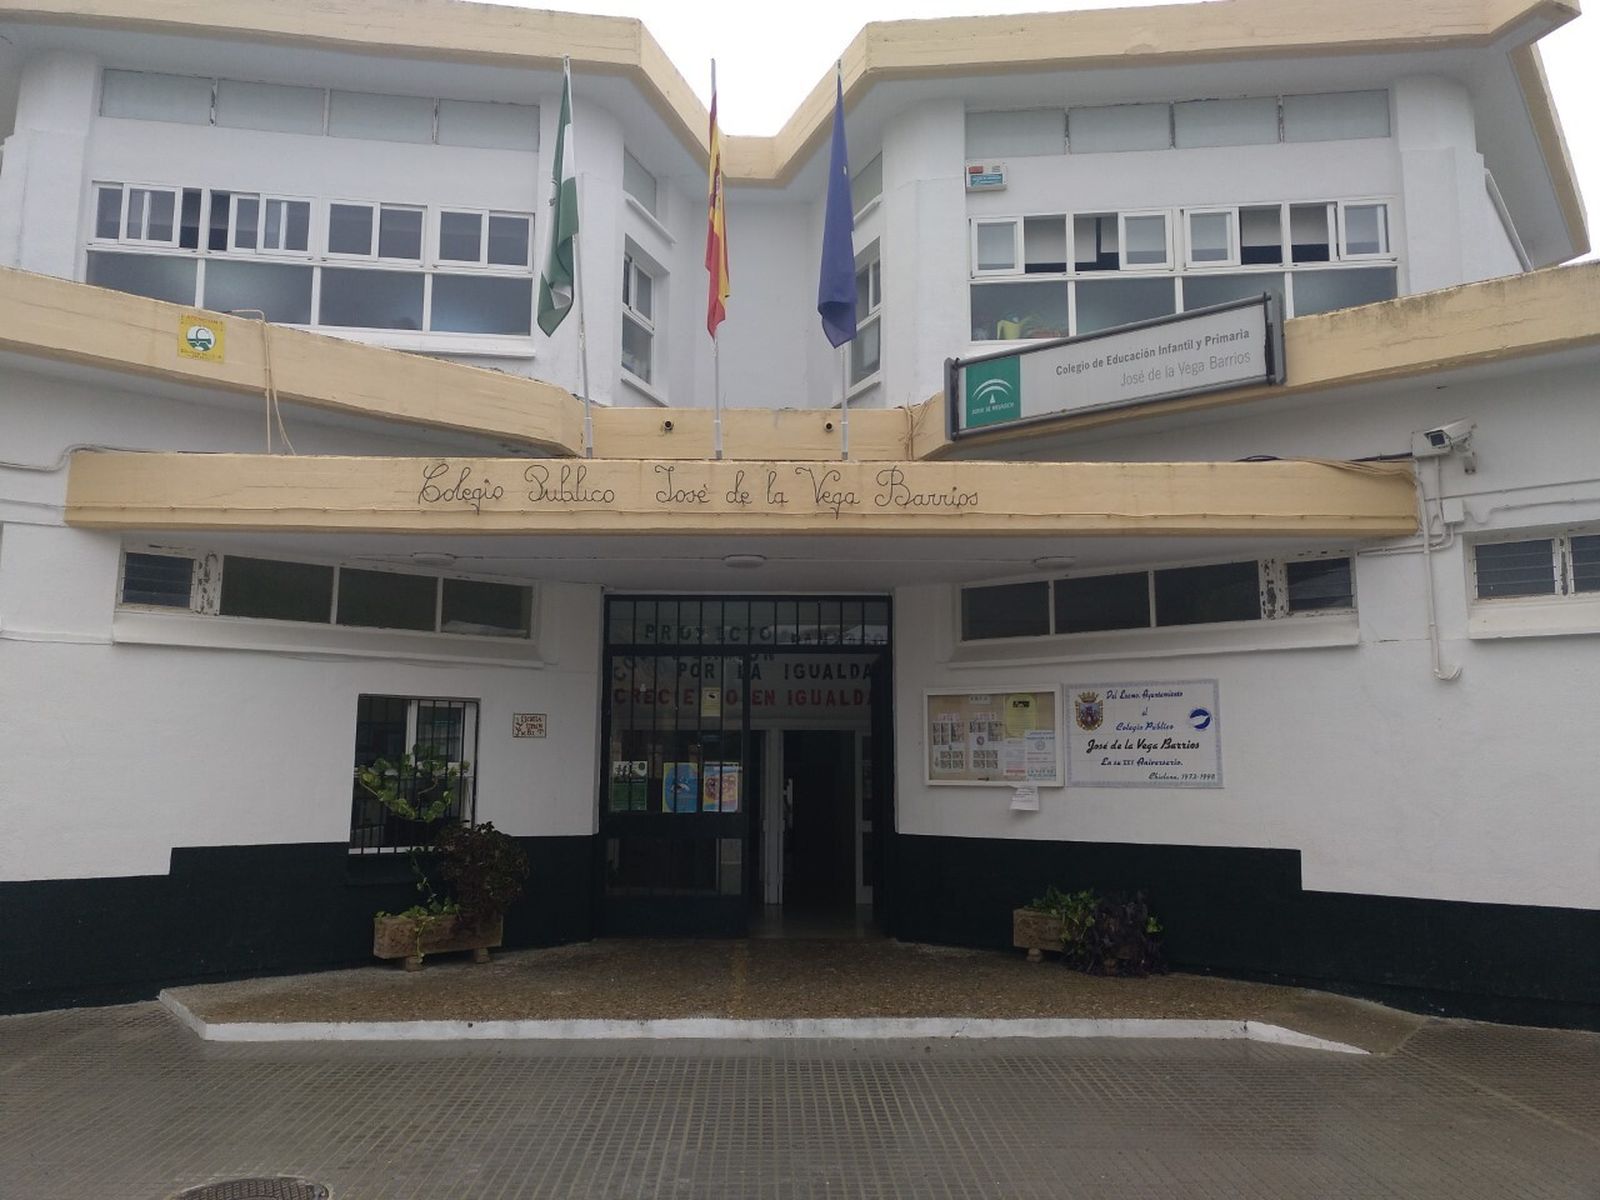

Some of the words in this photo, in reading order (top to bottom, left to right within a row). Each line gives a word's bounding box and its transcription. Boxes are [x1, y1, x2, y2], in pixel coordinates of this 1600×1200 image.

[1056, 363, 1090, 376] Colegio
[1092, 358, 1104, 369] de
[1106, 347, 1156, 366] Educación
[1159, 339, 1194, 355] Infantil
[1195, 339, 1202, 350] y
[1205, 328, 1250, 346] Primaria
[1121, 368, 1145, 386] José
[1148, 367, 1161, 382] de
[1165, 364, 1175, 378] la
[1178, 360, 1205, 376] Vega
[1209, 351, 1251, 370] Barrios
[417, 463, 504, 515] Colegio
[524, 464, 615, 503] Publico
[726, 470, 752, 505] de
[766, 471, 788, 505] la
[795, 467, 860, 519] Vega
[875, 465, 978, 508] Barrios
[679, 663, 714, 679] POR
[785, 664, 873, 680] IGUALDA
[615, 688, 738, 704] CRECEO
[752, 689, 775, 705] EN
[788, 689, 873, 705] IGUALD
[1116, 722, 1143, 733] Colegio
[1086, 739, 1108, 753] José
[1110, 740, 1122, 750] de
[1125, 739, 1134, 750] la
[1137, 738, 1158, 753] Vega
[1161, 738, 1200, 750] Barrios
